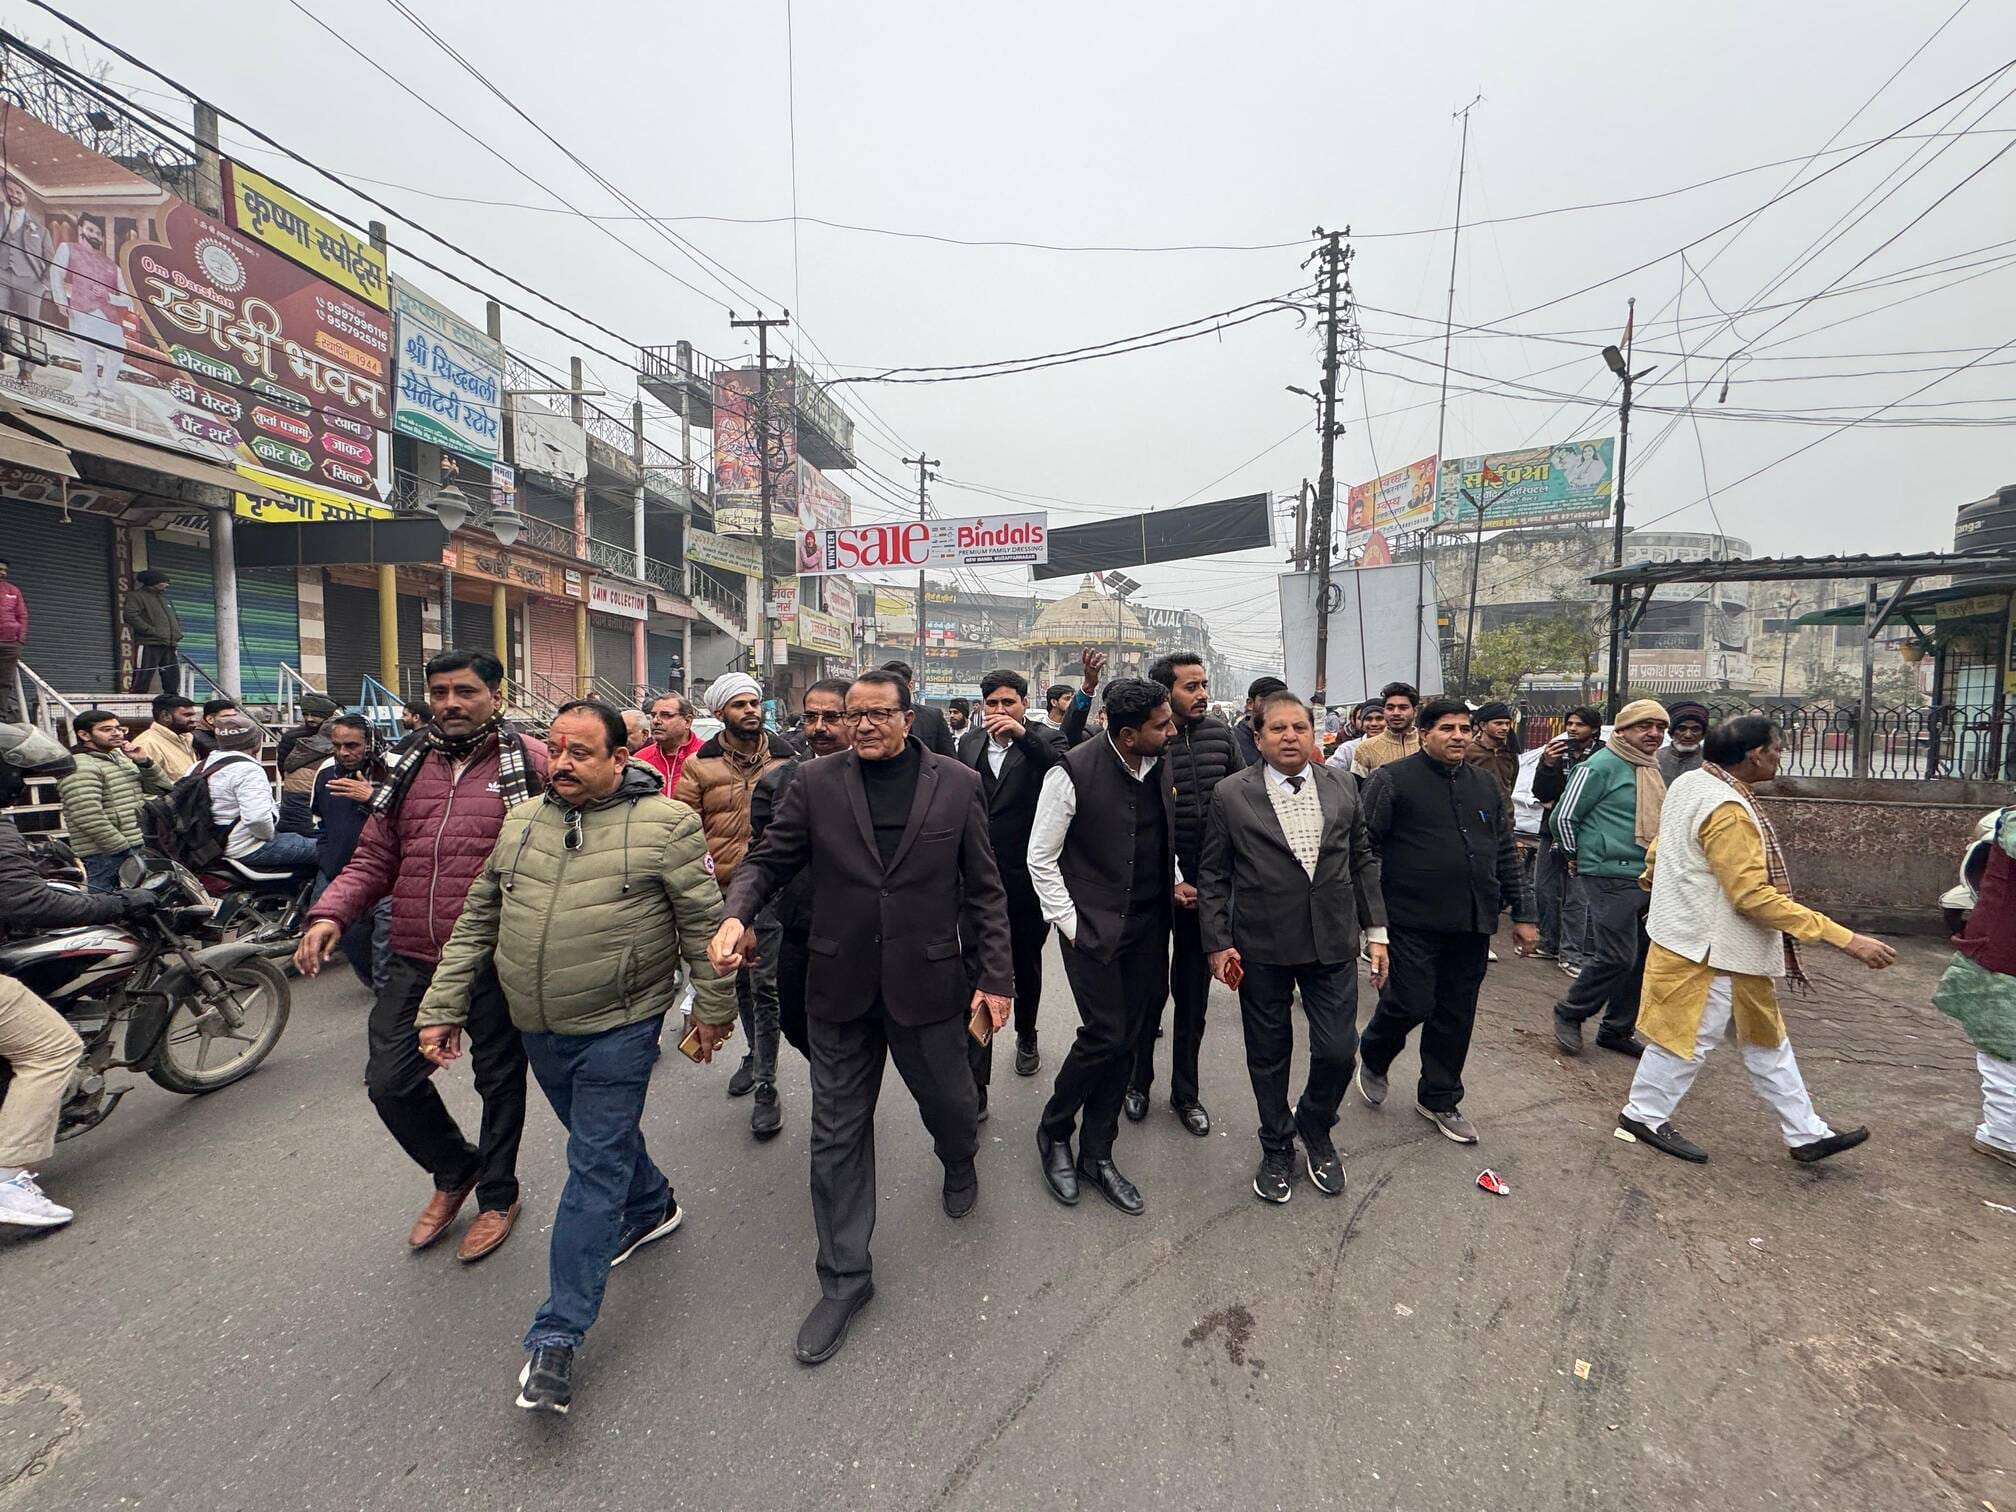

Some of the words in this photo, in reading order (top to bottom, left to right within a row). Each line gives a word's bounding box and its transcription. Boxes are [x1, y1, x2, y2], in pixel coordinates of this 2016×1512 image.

[241, 183, 310, 249] कृष्णा
[314, 228, 382, 296] स्पोर्ट्स
[141, 255, 170, 279] Om
[172, 270, 235, 310] Darshan
[327, 300, 388, 341] 9997996116
[327, 313, 387, 352] 9557925515
[146, 277, 284, 380] खादी
[283, 340, 386, 418] भवन
[406, 335, 427, 365] श्री
[177, 351, 232, 383] शेरवानी
[356, 354, 378, 373] 1944
[170, 381, 196, 402] इंडो
[463, 405, 498, 439] स्टोर
[259, 443, 285, 461] कोट
[332, 464, 363, 485] सिल्क
[838, 523, 929, 568] sale
[958, 521, 1044, 548] Bindals
[827, 533, 836, 568] WINTER
[592, 584, 608, 602] JAIN
[610, 590, 645, 610] COLLECTION
[1148, 609, 1182, 628] KAJAL
[1629, 664, 1639, 677] म
[1640, 664, 1667, 678] प्रकाश
[1668, 664, 1685, 677] एण्ड
[1686, 659, 1702, 677] संस
